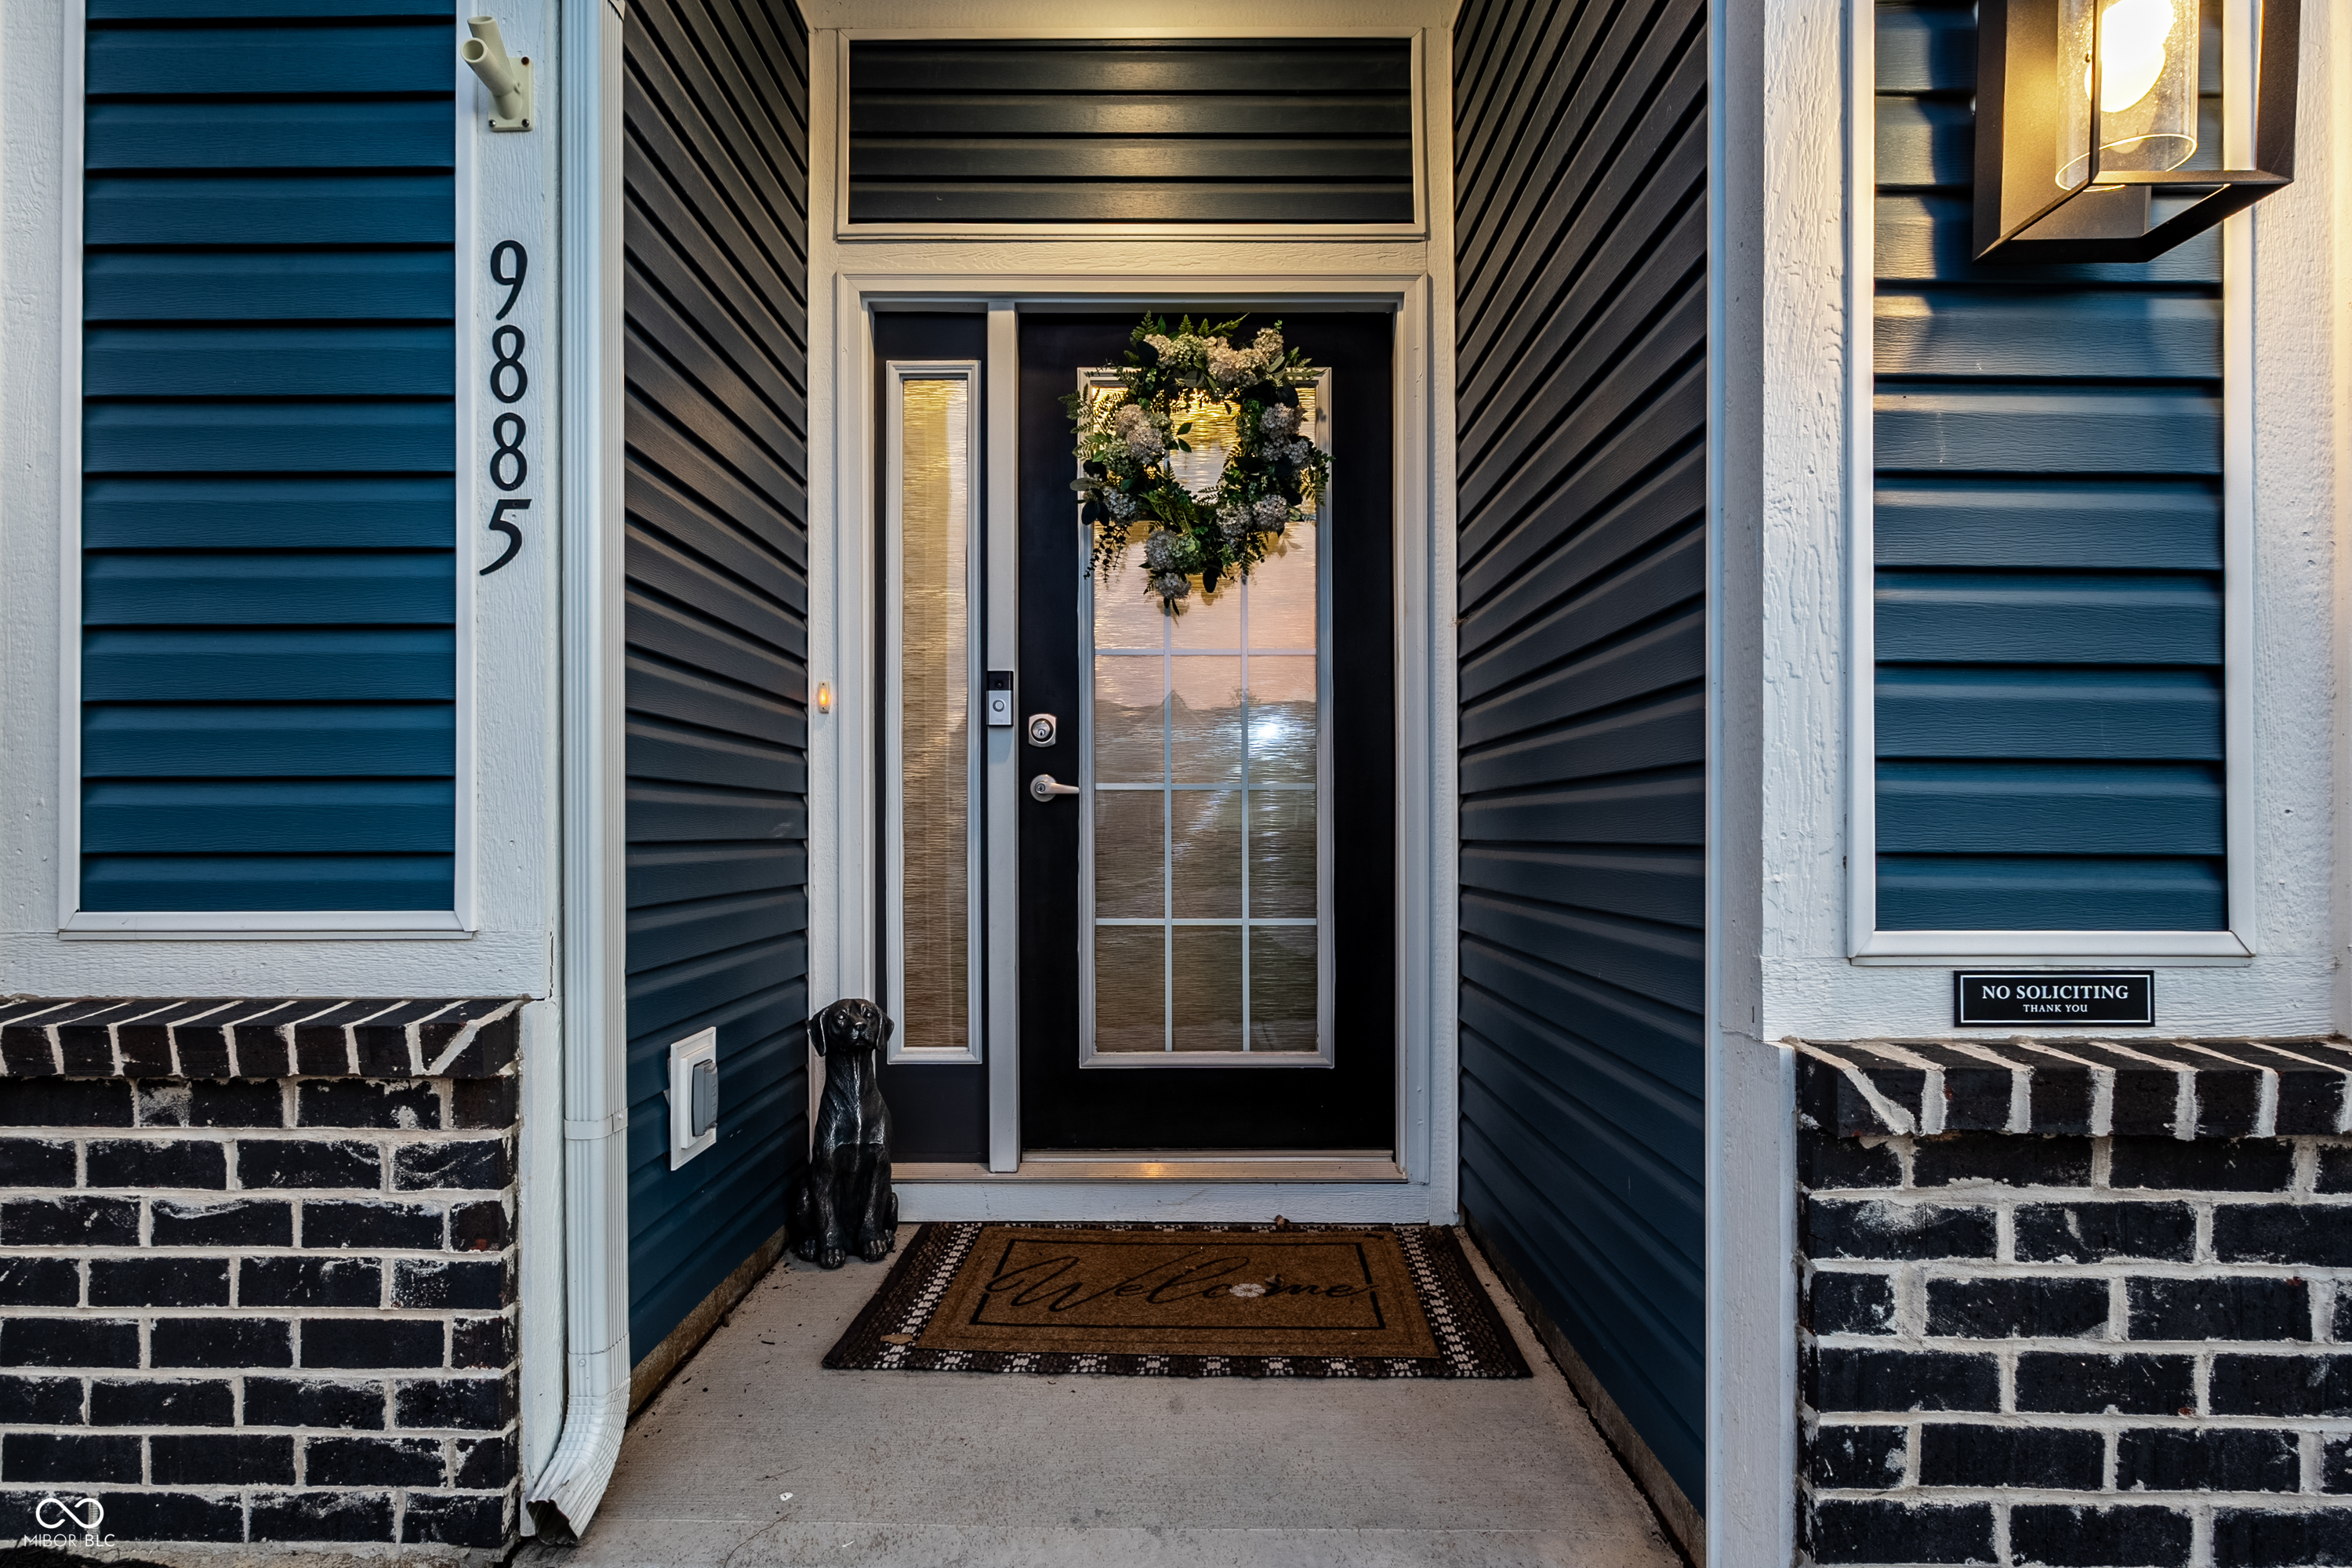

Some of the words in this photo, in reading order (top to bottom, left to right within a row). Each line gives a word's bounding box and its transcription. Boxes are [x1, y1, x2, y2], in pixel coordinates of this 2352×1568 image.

[479, 240, 532, 575] 9885
[1981, 985, 2011, 1000] NO
[2016, 985, 2129, 1000] SOLICITING
[2023, 1004, 2062, 1013] THANK
[2064, 1004, 2089, 1013] YOU
